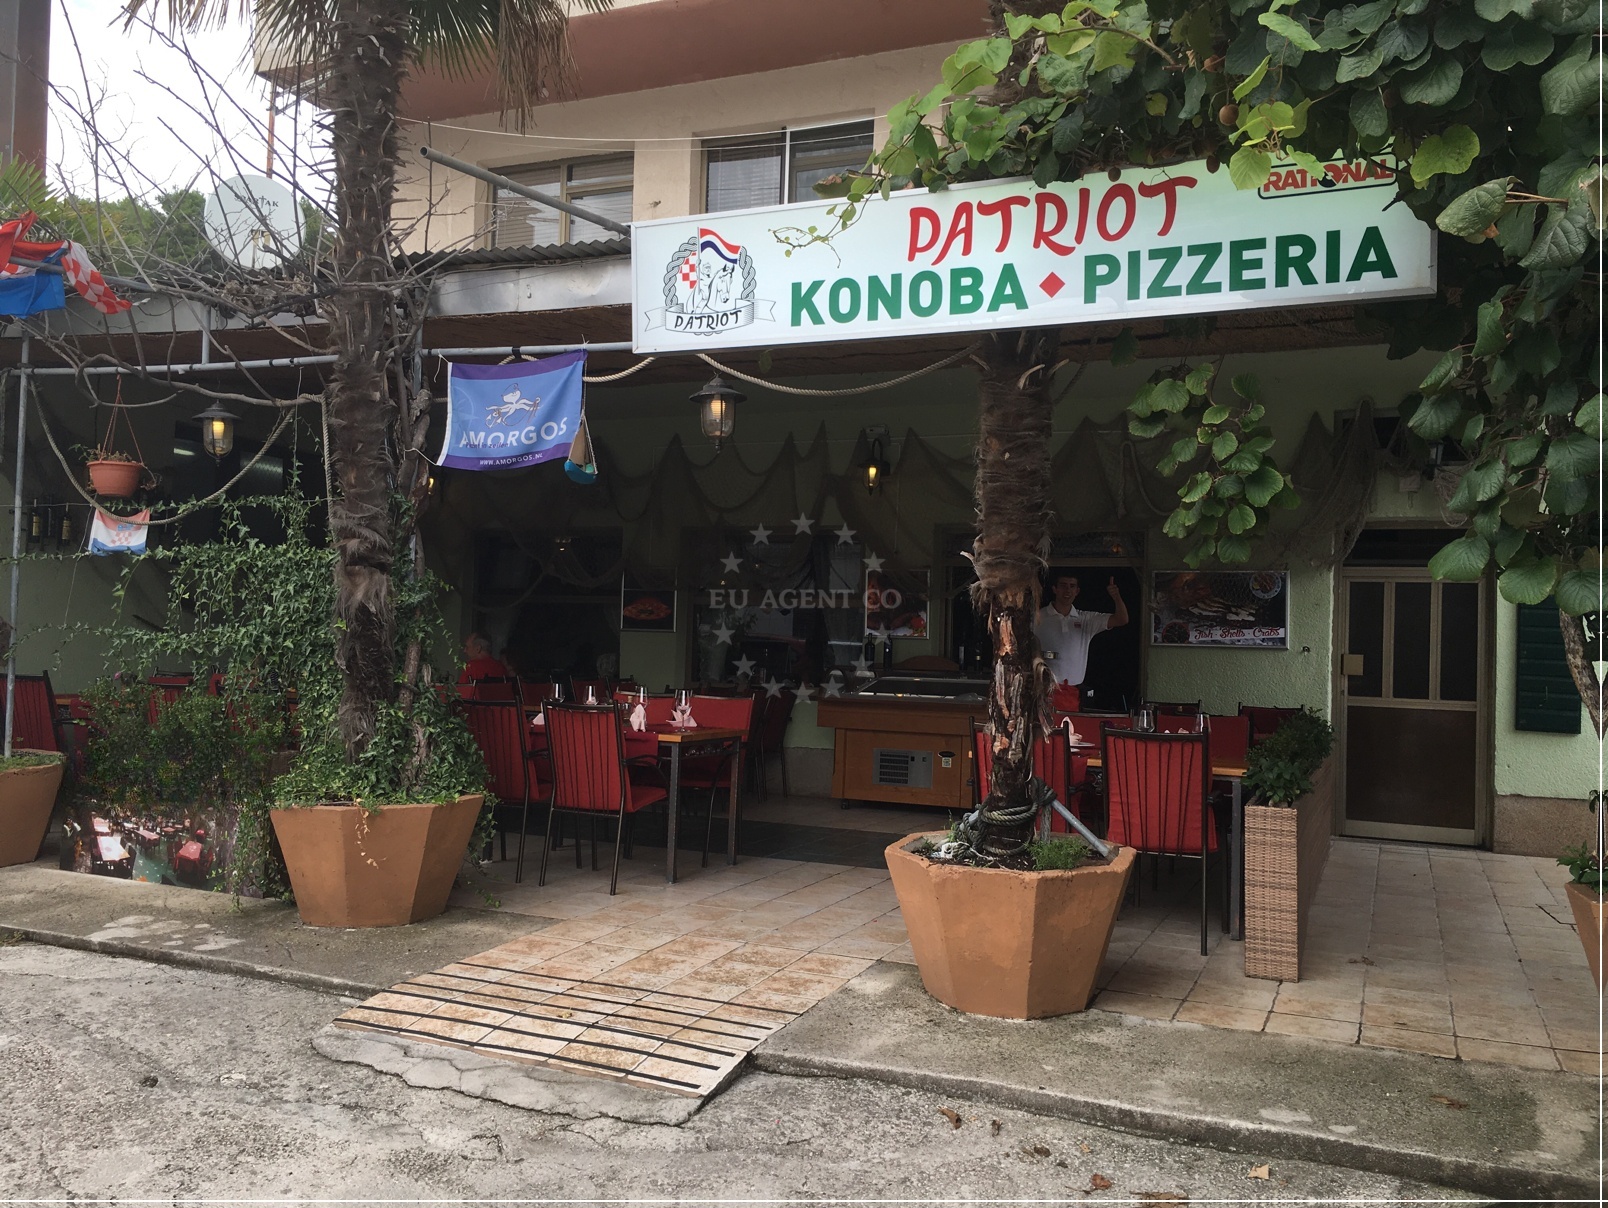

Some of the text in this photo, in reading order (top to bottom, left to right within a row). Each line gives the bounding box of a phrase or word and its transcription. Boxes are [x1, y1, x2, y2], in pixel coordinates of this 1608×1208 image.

[908, 175, 1198, 265] PATRIOT
[790, 225, 1399, 327] KONOBA PIZZERIA
[674, 310, 742, 330] PATRIOT
[459, 418, 567, 449] AMORGOS
[1252, 627, 1281, 638] Crabs
